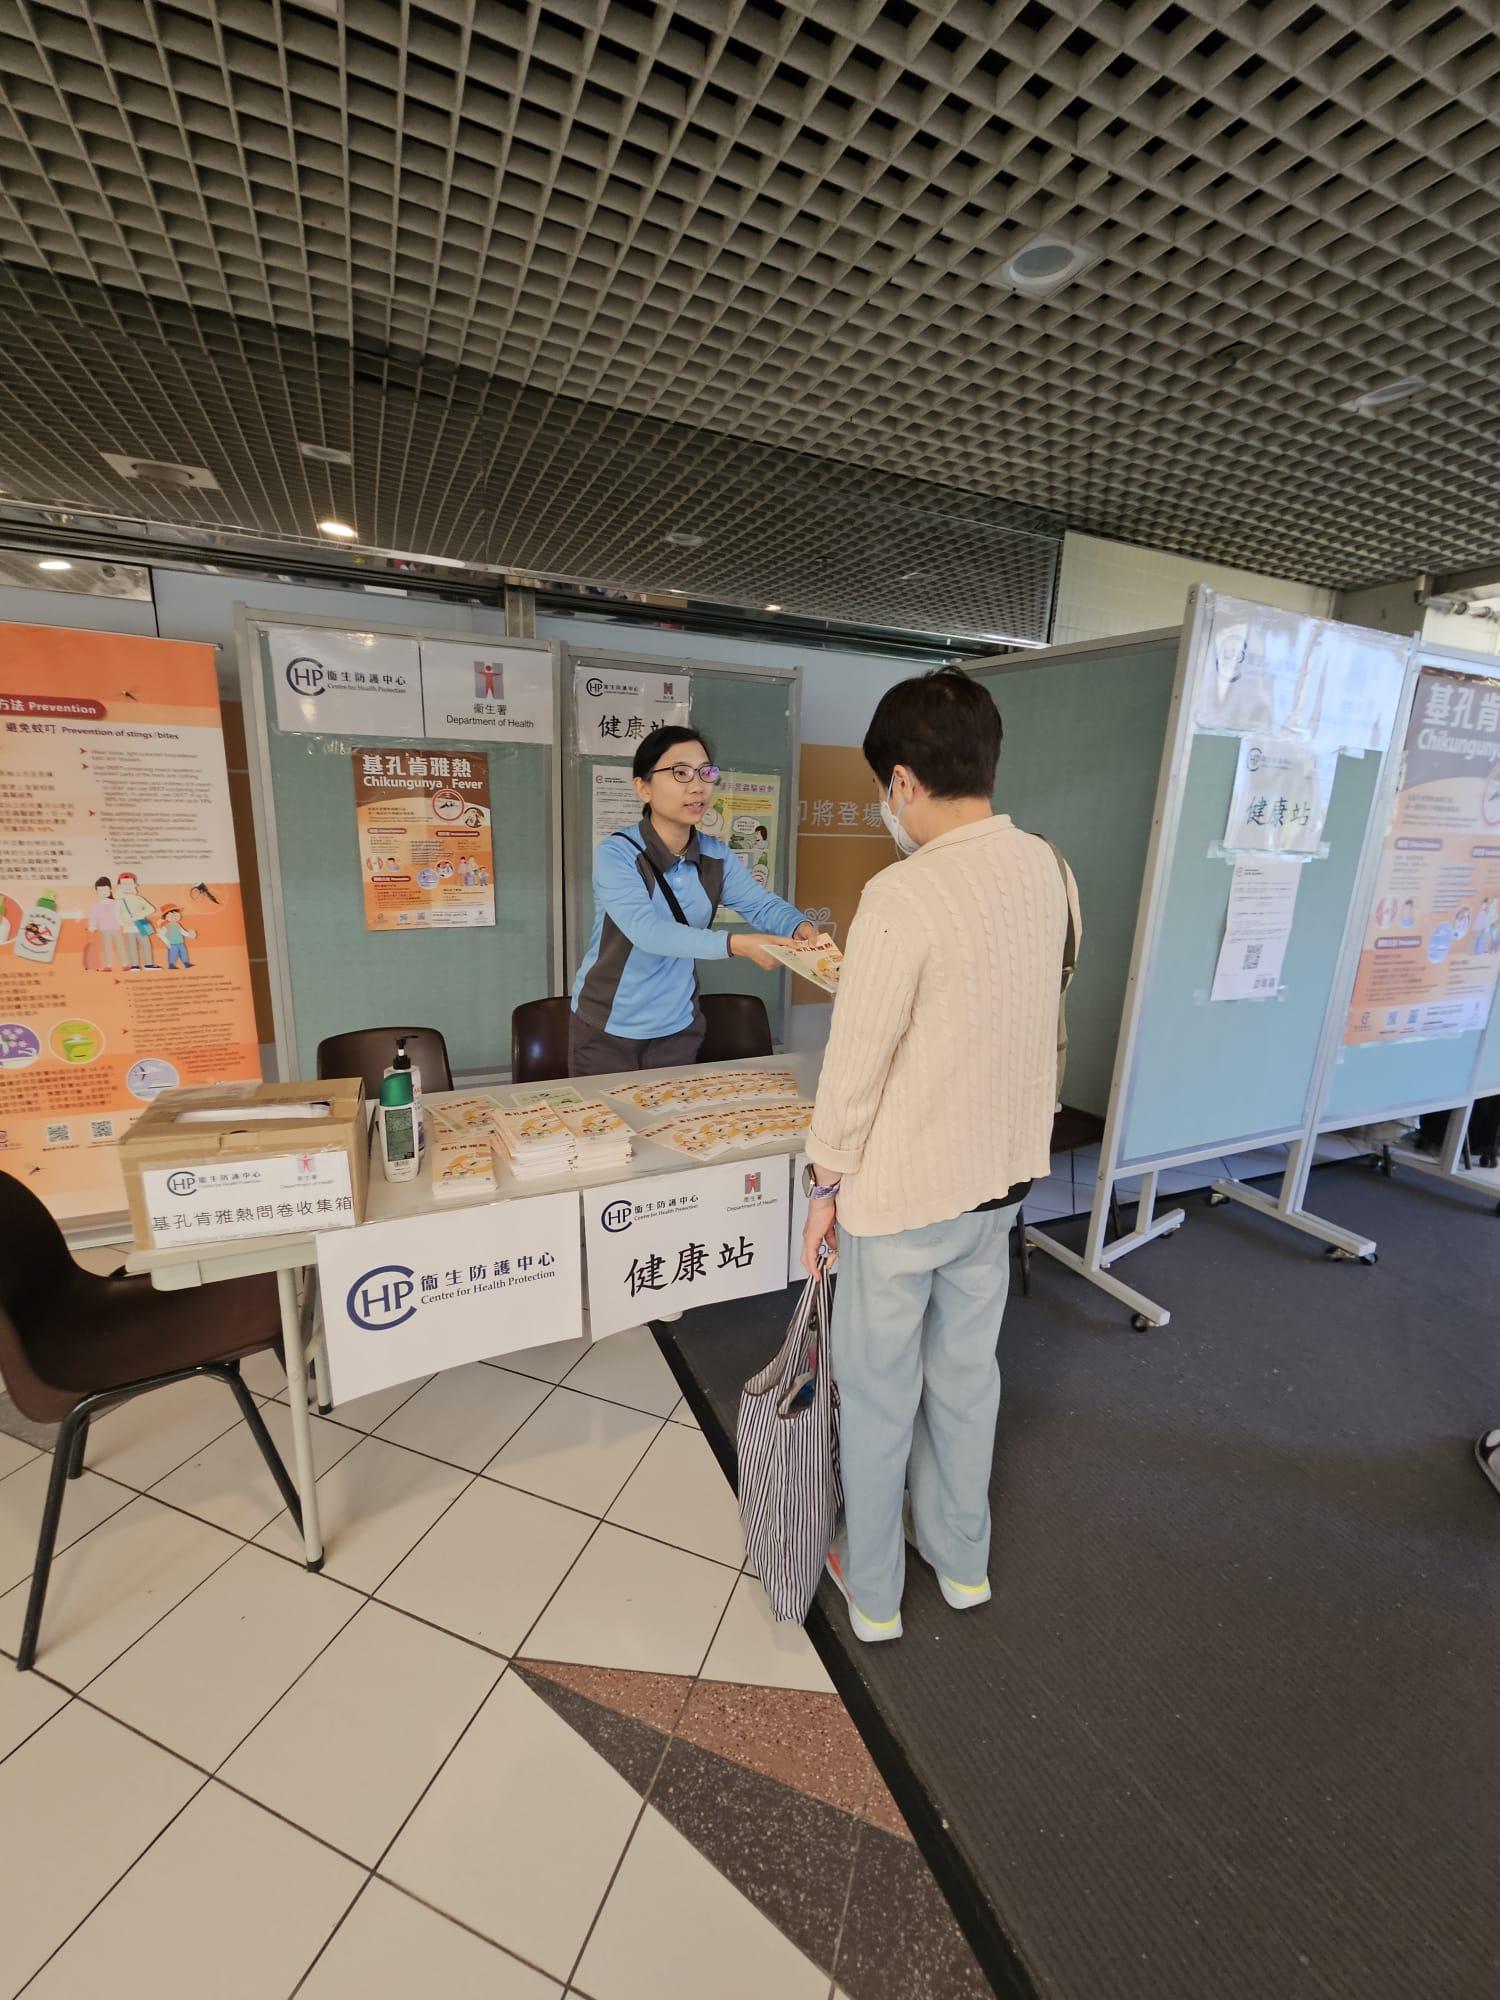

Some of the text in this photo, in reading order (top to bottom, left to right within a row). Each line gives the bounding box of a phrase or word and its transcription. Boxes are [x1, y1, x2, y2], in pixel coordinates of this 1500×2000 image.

[28, 701, 97, 714] Prevention
[6, 722, 56, 735] 避免蚊叮
[62, 726, 114, 737] Prevention
[446, 714, 534, 728] Department of Health
[362, 754, 472, 778] 基孔肯雅熱
[363, 776, 483, 790] Chikungunya Fever
[167, 1171, 198, 1196] CHP
[152, 1196, 352, 1232] 基孔肯雅熱問卷收集箱
[601, 1199, 632, 1232] CHP
[659, 1208, 675, 1216] Health
[675, 1204, 699, 1213] Protection
[624, 1236, 754, 1298] 健康站
[346, 1265, 418, 1331] CHP
[421, 1269, 555, 1305] Centre for Health Protection
